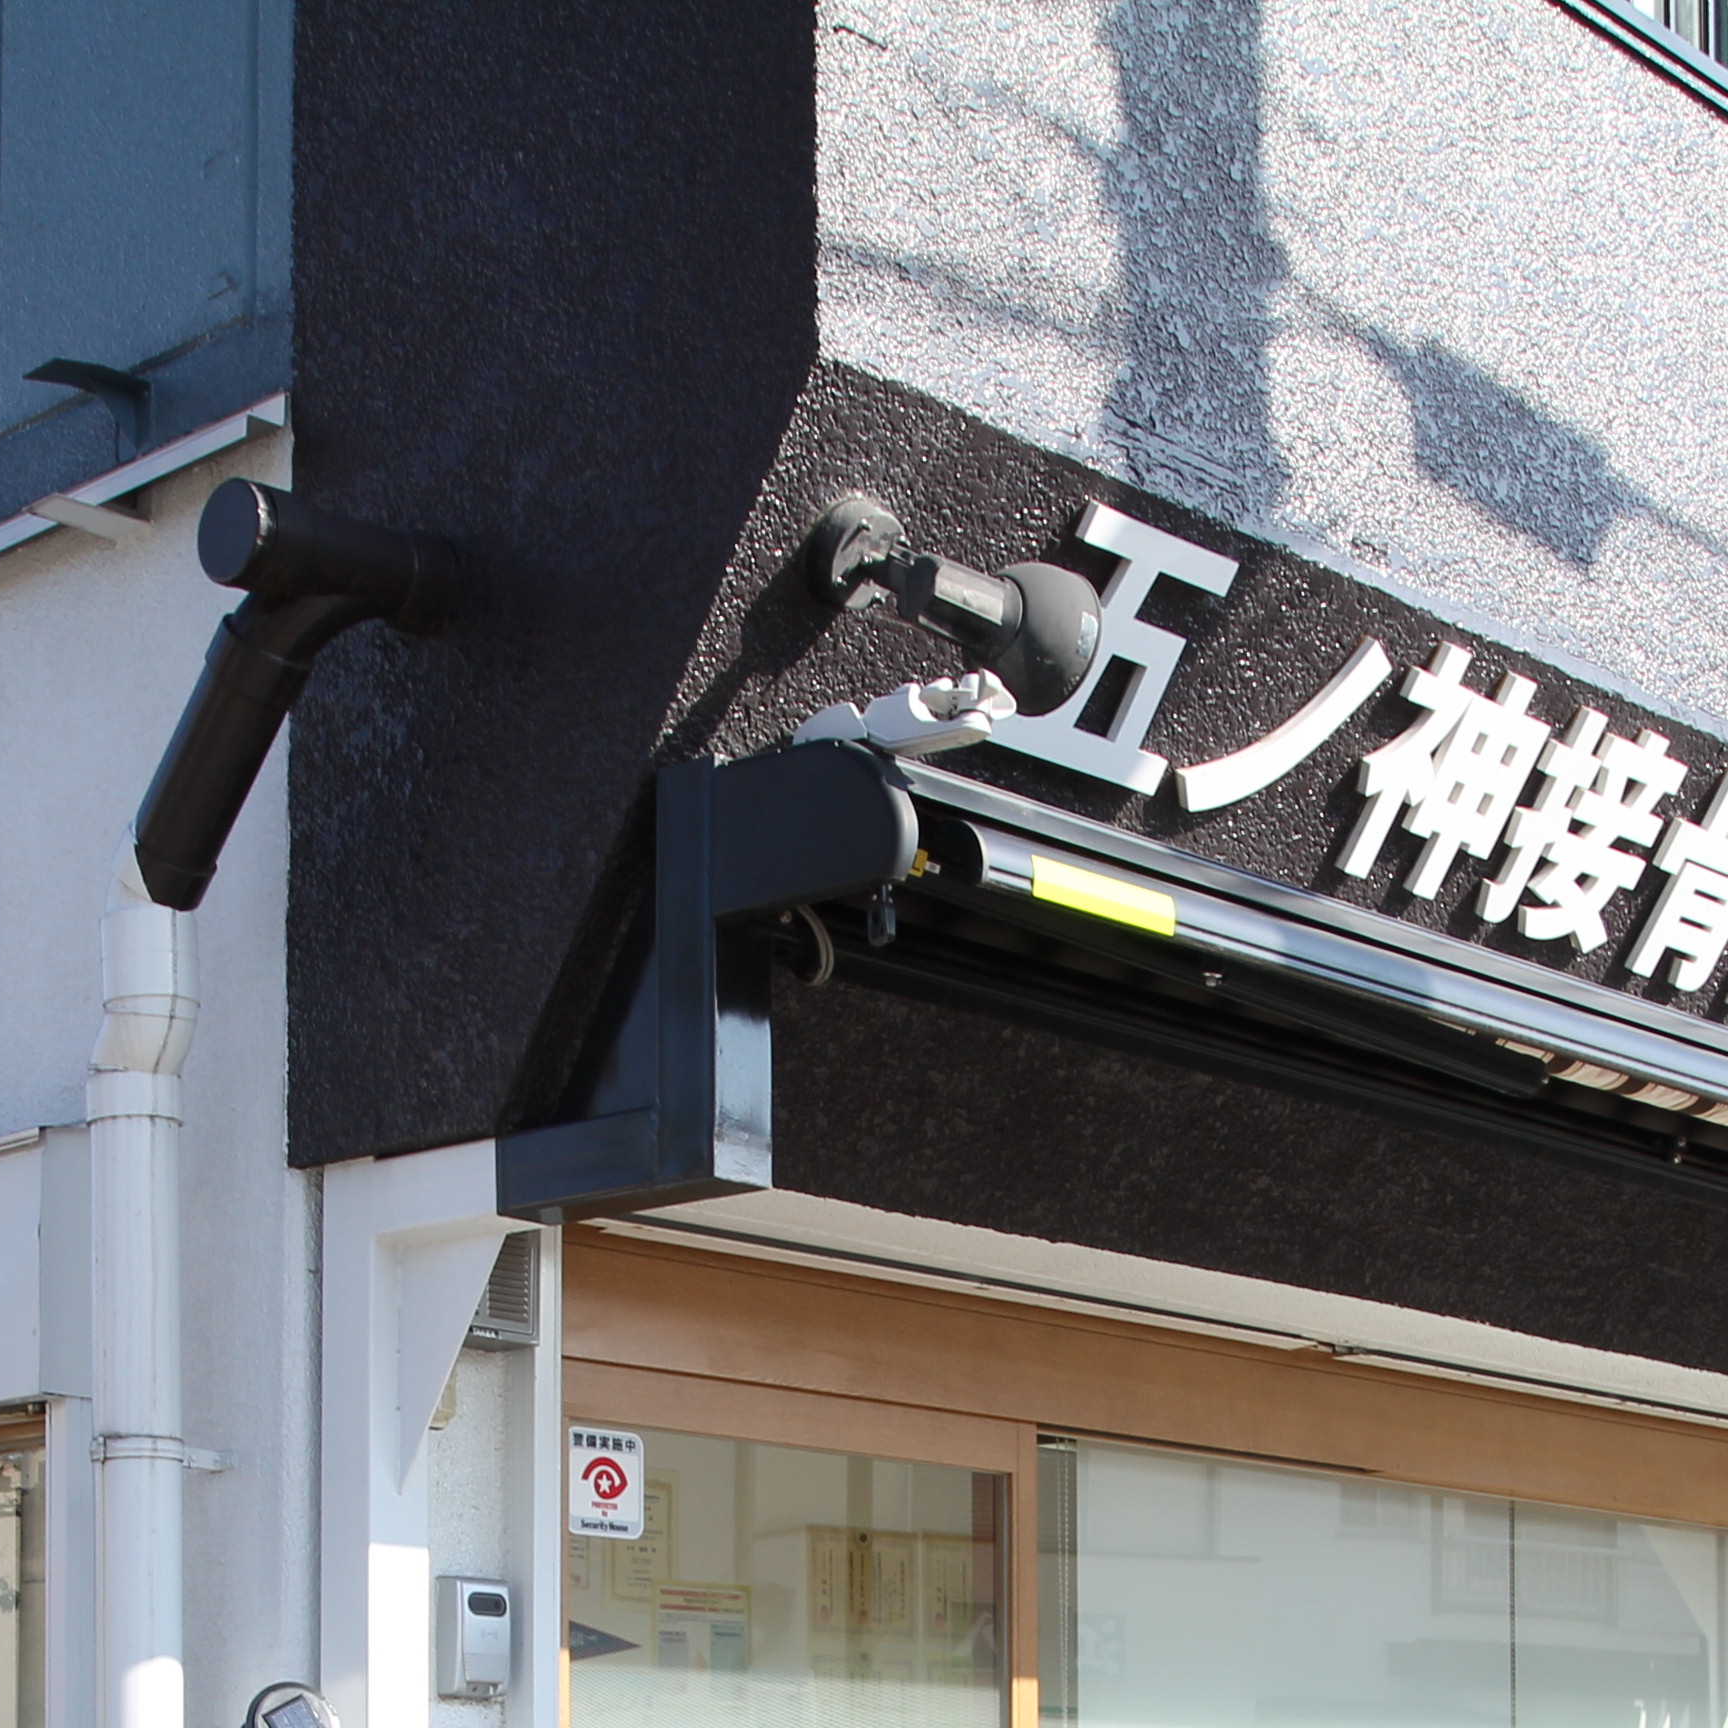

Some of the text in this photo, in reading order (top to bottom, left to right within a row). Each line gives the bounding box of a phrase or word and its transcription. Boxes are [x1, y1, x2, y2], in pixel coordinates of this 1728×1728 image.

[573, 1432, 636, 1452] 警備実施中
